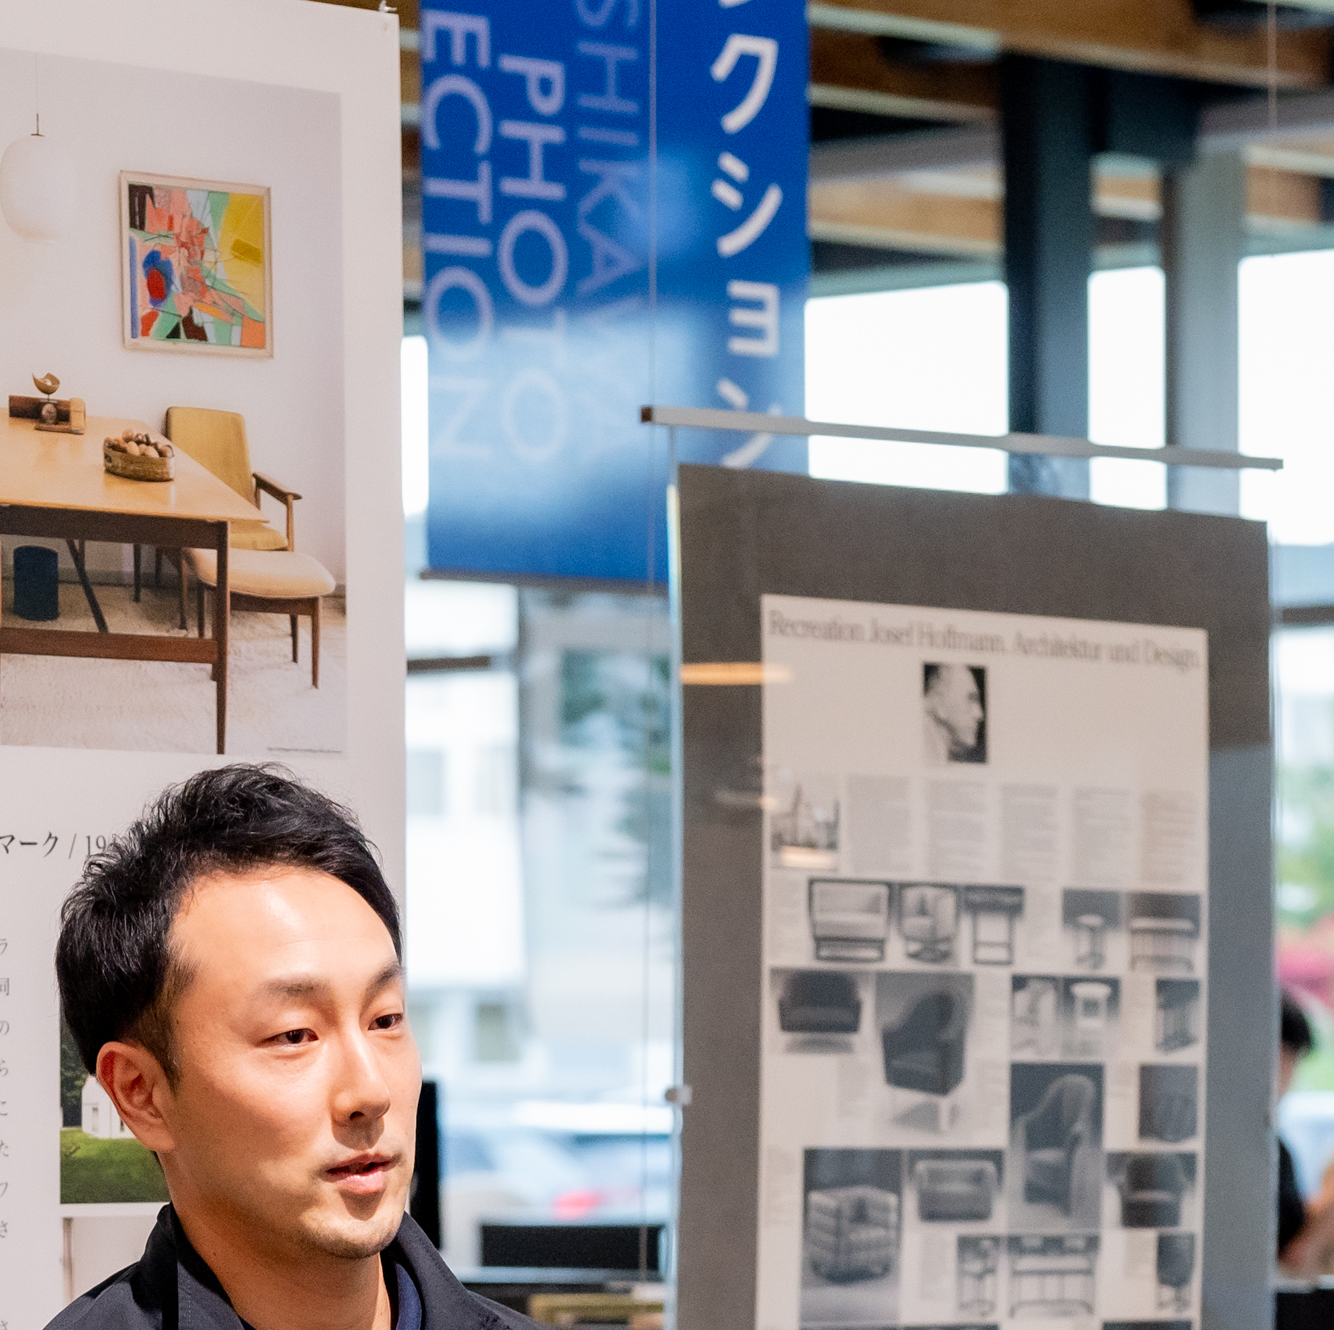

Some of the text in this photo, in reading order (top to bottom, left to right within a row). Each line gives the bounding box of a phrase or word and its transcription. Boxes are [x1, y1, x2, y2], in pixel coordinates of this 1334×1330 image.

[420, 8, 494, 461] ECTION
[499, 54, 569, 464] PHOTO
[711, 0, 782, 469] クション
